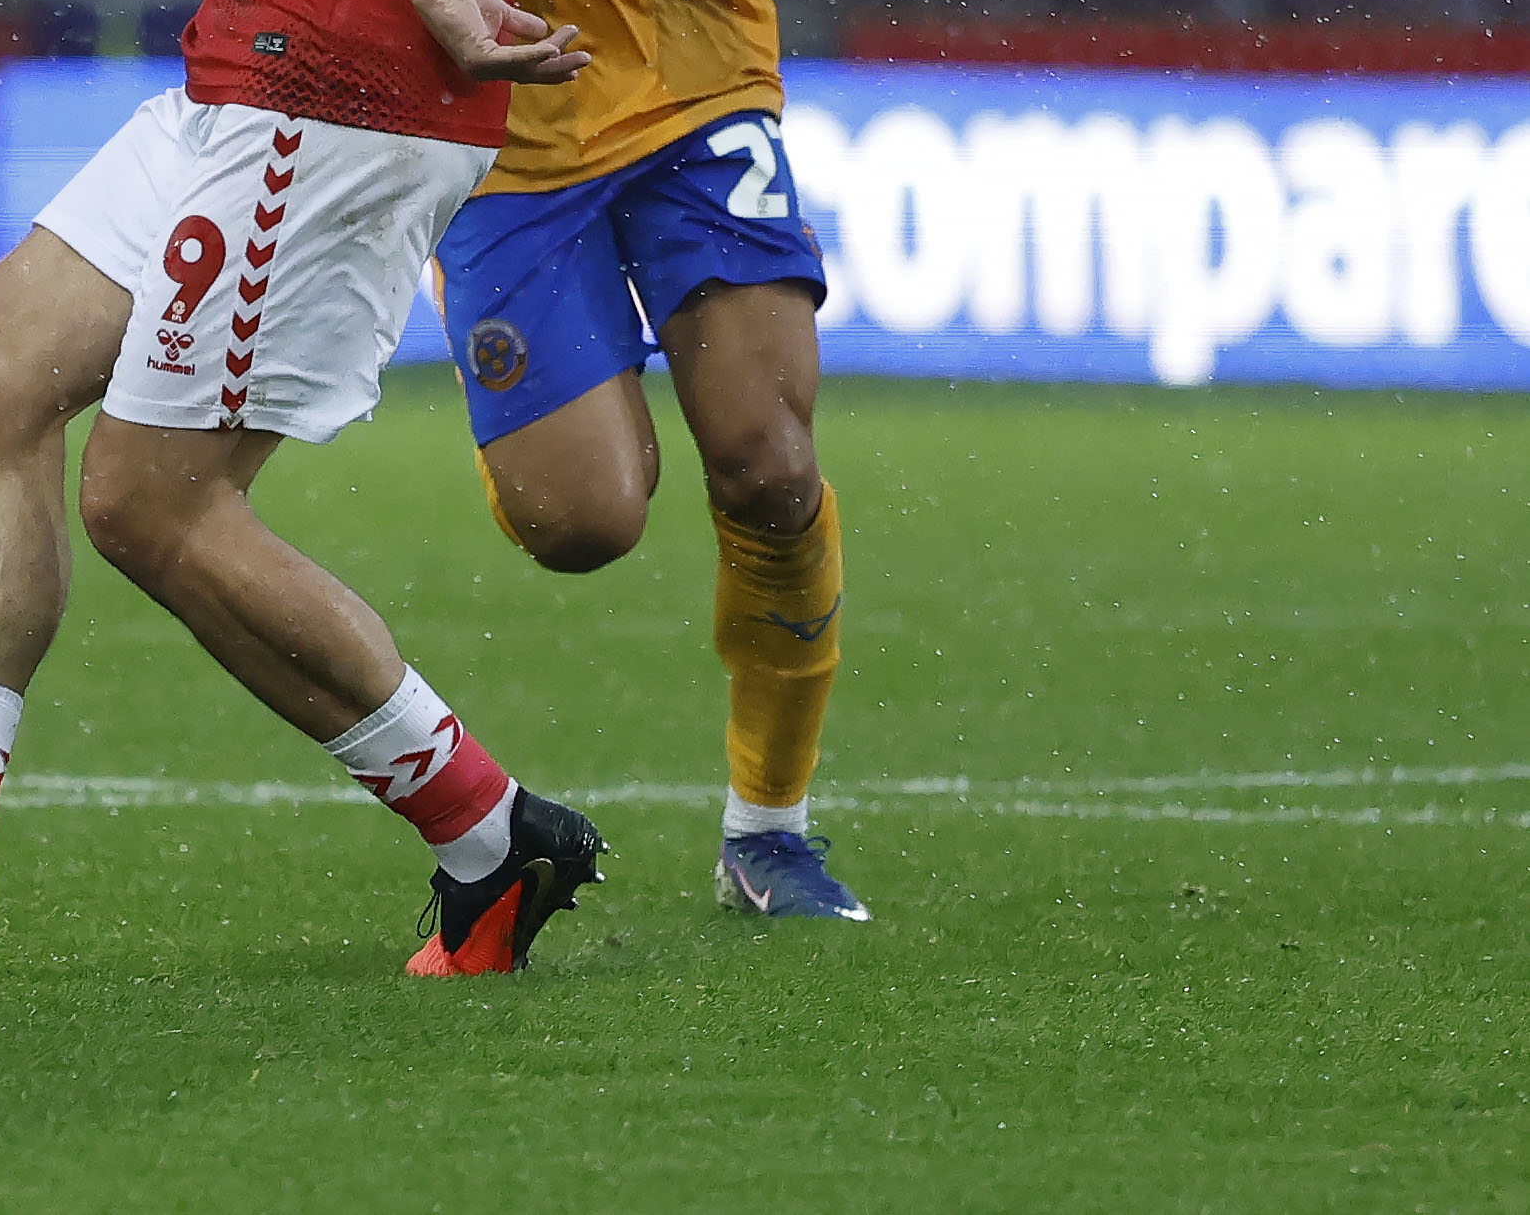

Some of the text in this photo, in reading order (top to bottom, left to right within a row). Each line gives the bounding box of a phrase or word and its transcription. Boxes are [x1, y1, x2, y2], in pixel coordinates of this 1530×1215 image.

[706, 116, 788, 219] 2
[161, 215, 226, 324] 9
[147, 354, 196, 376] hummel
